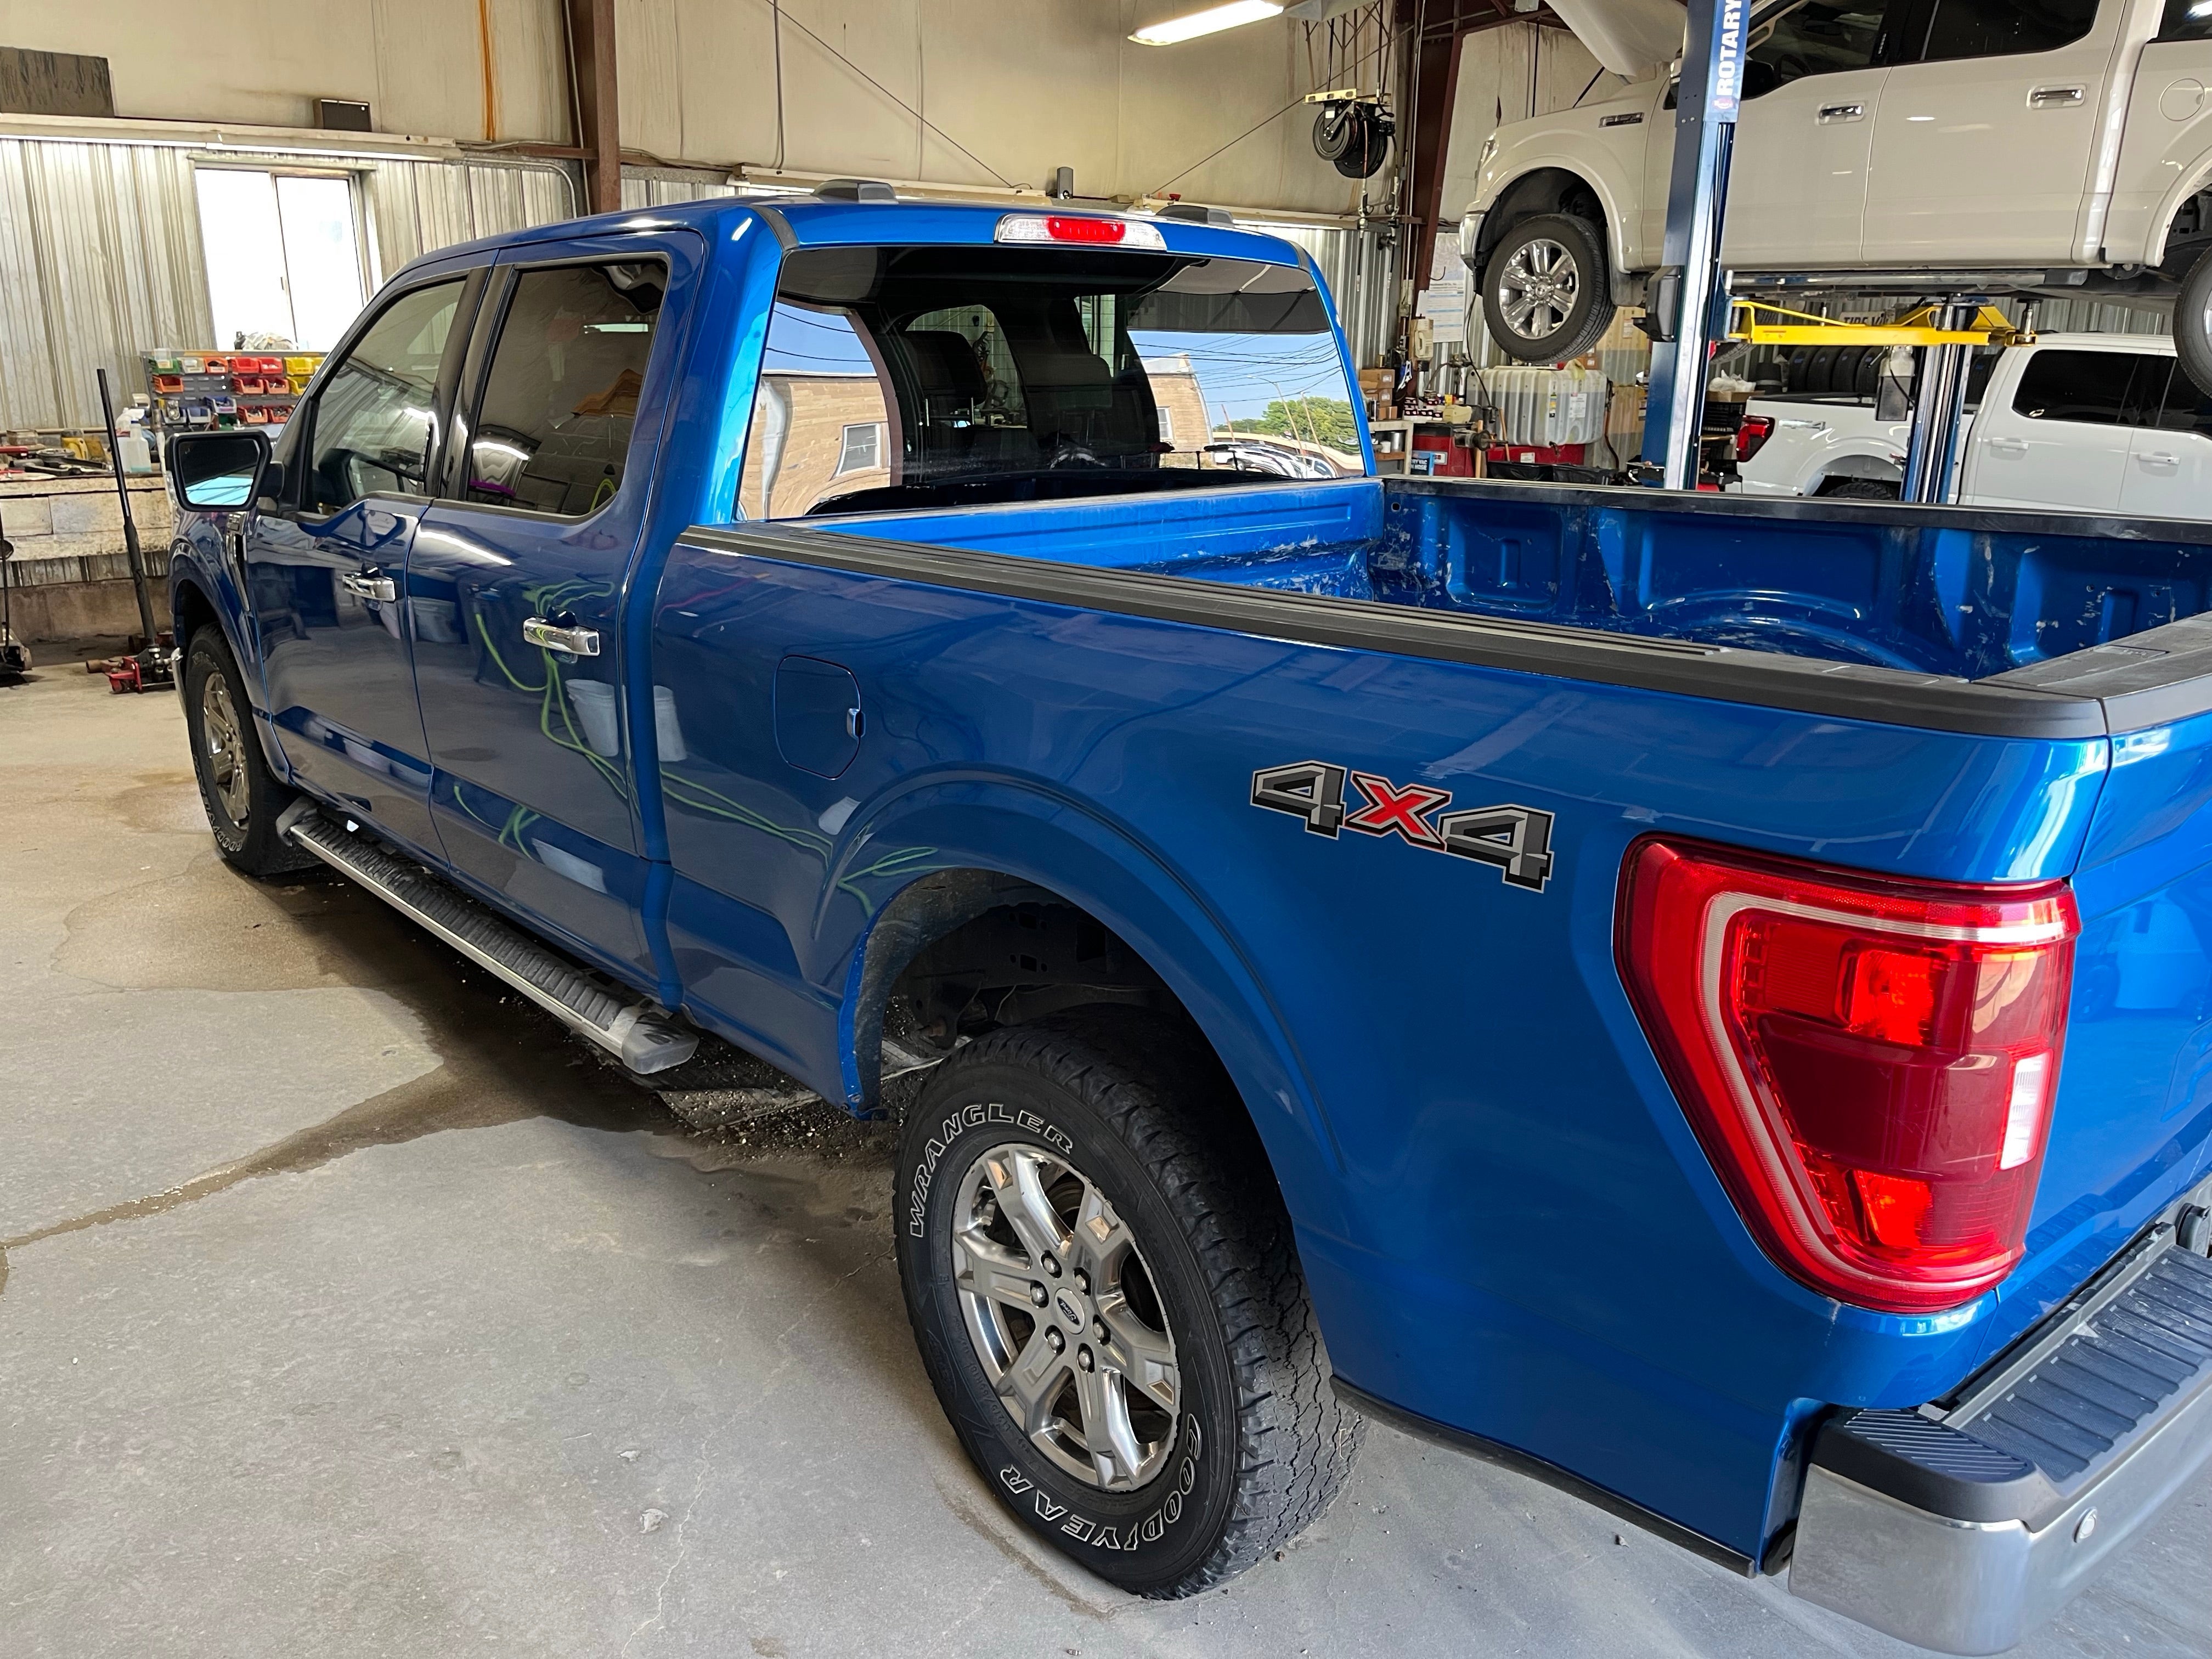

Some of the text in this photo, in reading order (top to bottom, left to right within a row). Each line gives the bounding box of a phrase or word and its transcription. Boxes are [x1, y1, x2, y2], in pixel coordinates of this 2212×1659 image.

[1717, 0, 1742, 95] ROTARY
[910, 1103, 1073, 1238] WRANGLER
[1059, 1301, 1077, 1321] Ford
[1000, 1414, 1201, 1551] GOODYEAR
